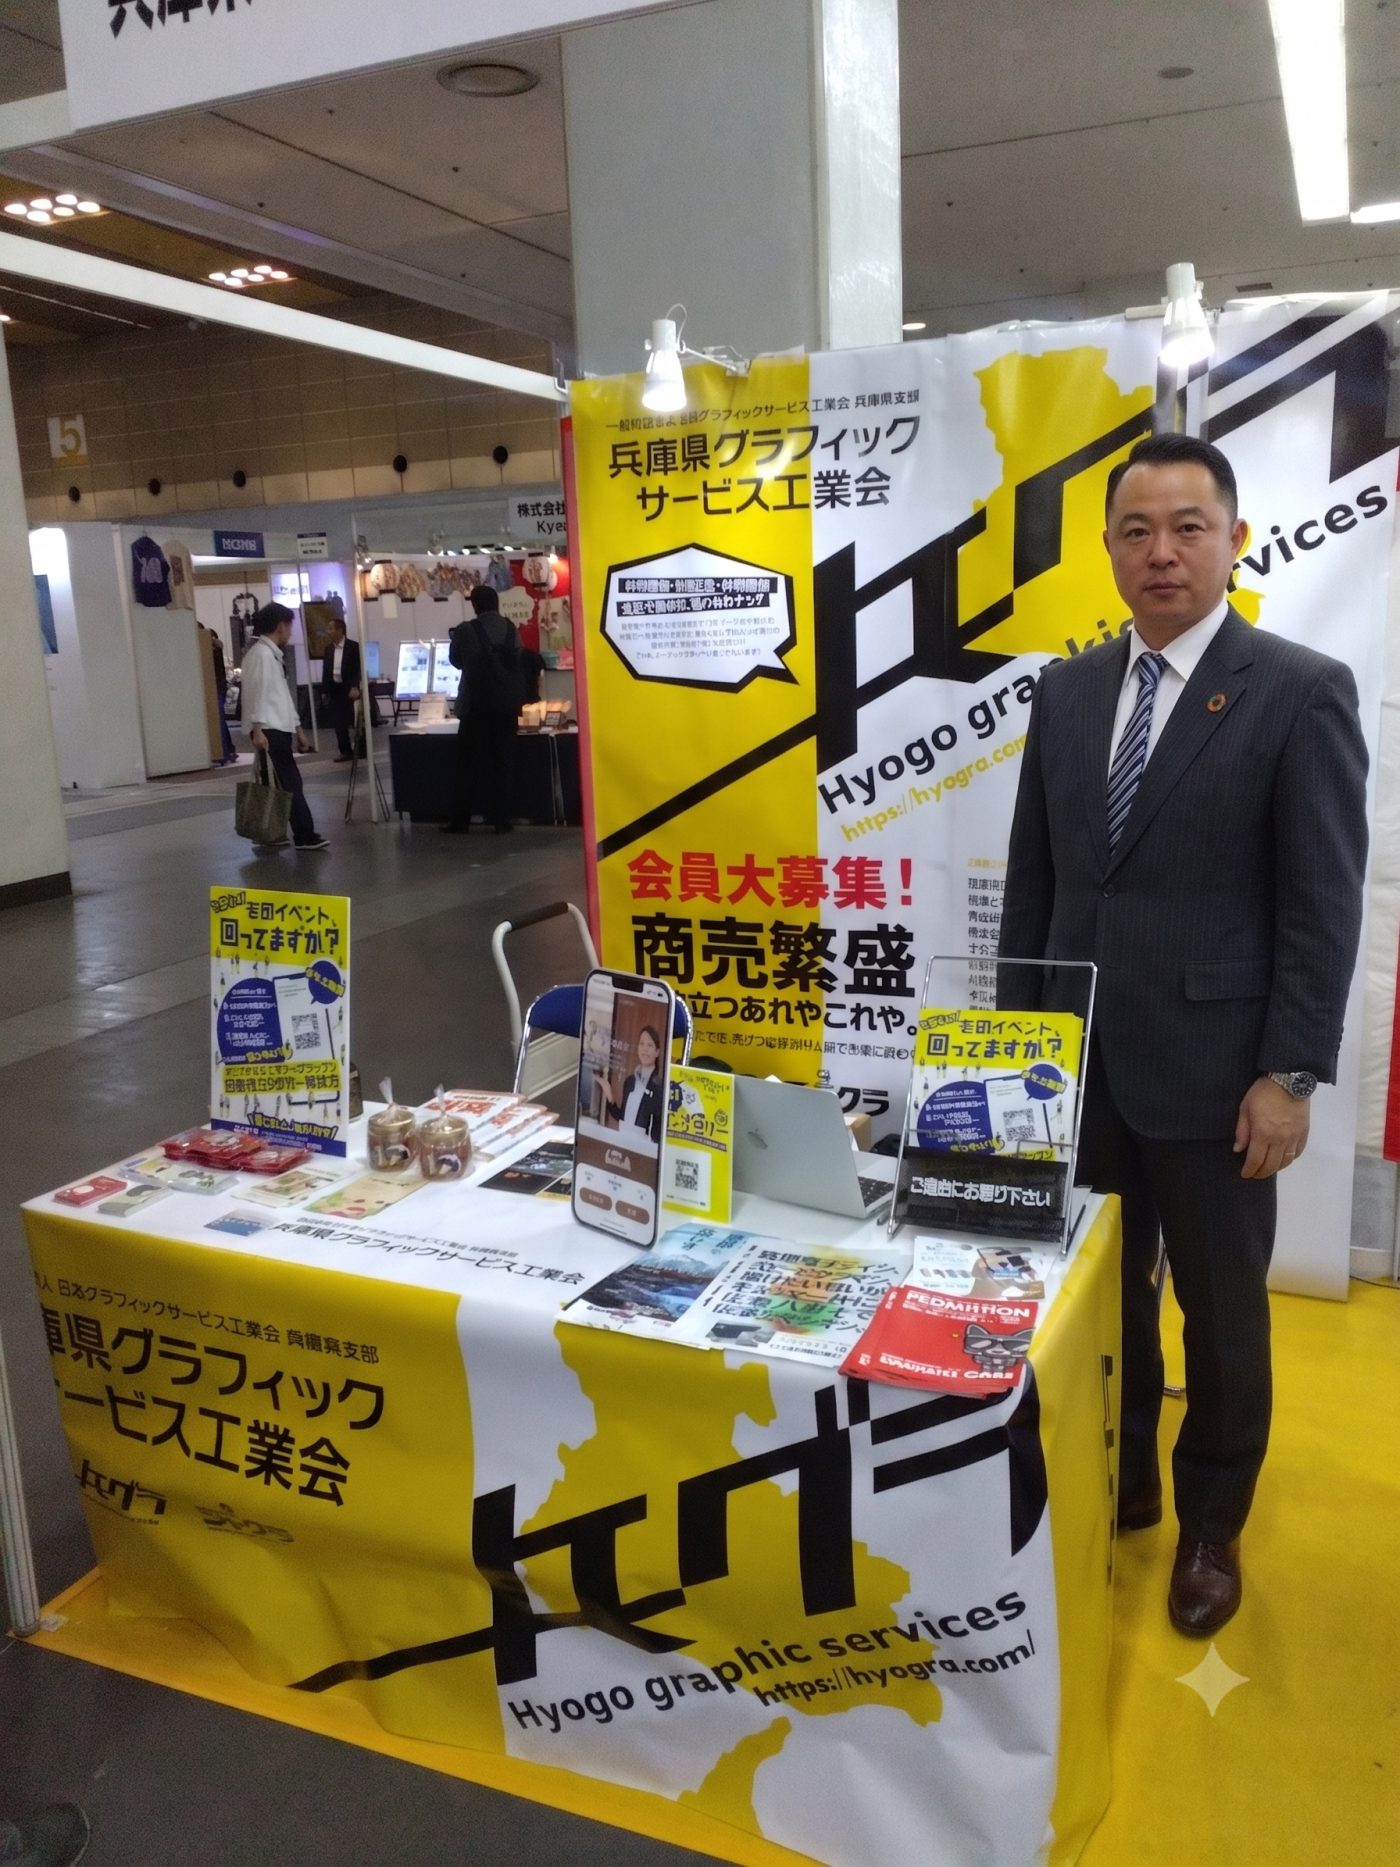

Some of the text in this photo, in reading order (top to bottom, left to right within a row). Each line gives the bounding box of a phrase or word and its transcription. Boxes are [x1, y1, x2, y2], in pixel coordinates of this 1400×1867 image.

[60, 414, 82, 457] 5
[609, 416, 920, 478] 兵庫県グラフィック
[636, 466, 892, 521] サービス工業会
[818, 724, 958, 814] Hyogo
[631, 912, 916, 998] 商売繁盛
[677, 989, 917, 1036] 立つあれやこれや。
[508, 1588, 1028, 1733] Hyogo graphic services
[753, 1628, 1037, 1706] https://hyogra.com/
